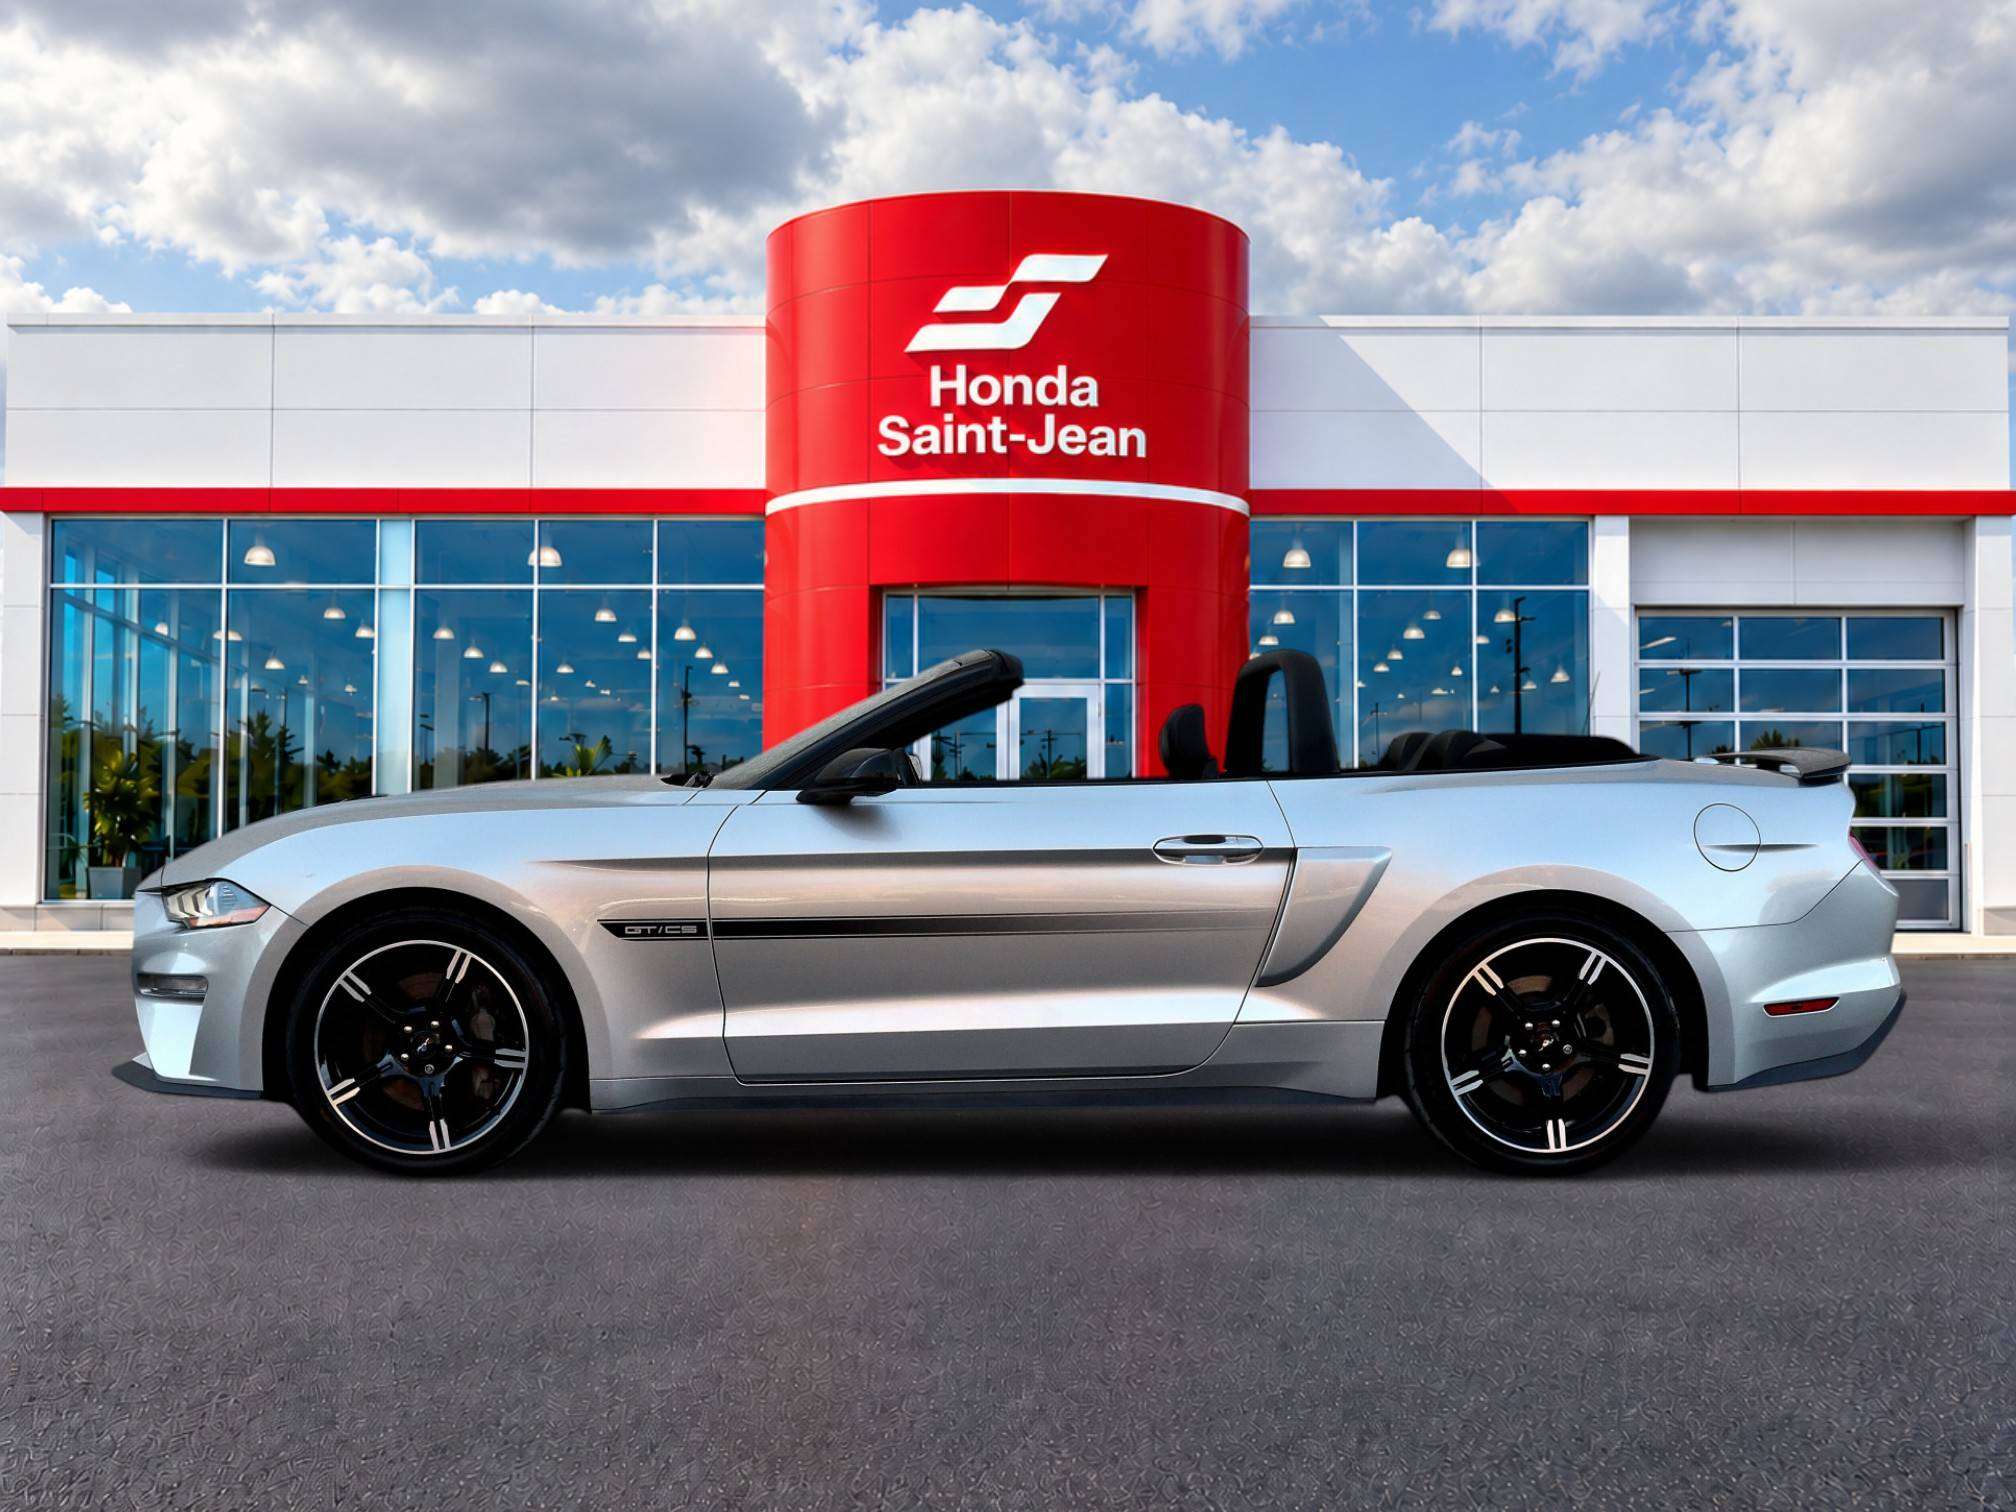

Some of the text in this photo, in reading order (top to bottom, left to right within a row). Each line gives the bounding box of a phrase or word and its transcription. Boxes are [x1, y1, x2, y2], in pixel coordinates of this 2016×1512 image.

[929, 364, 1099, 407] Honda
[877, 413, 1147, 457] Saint-Jean
[624, 925, 697, 934] GT/CS
